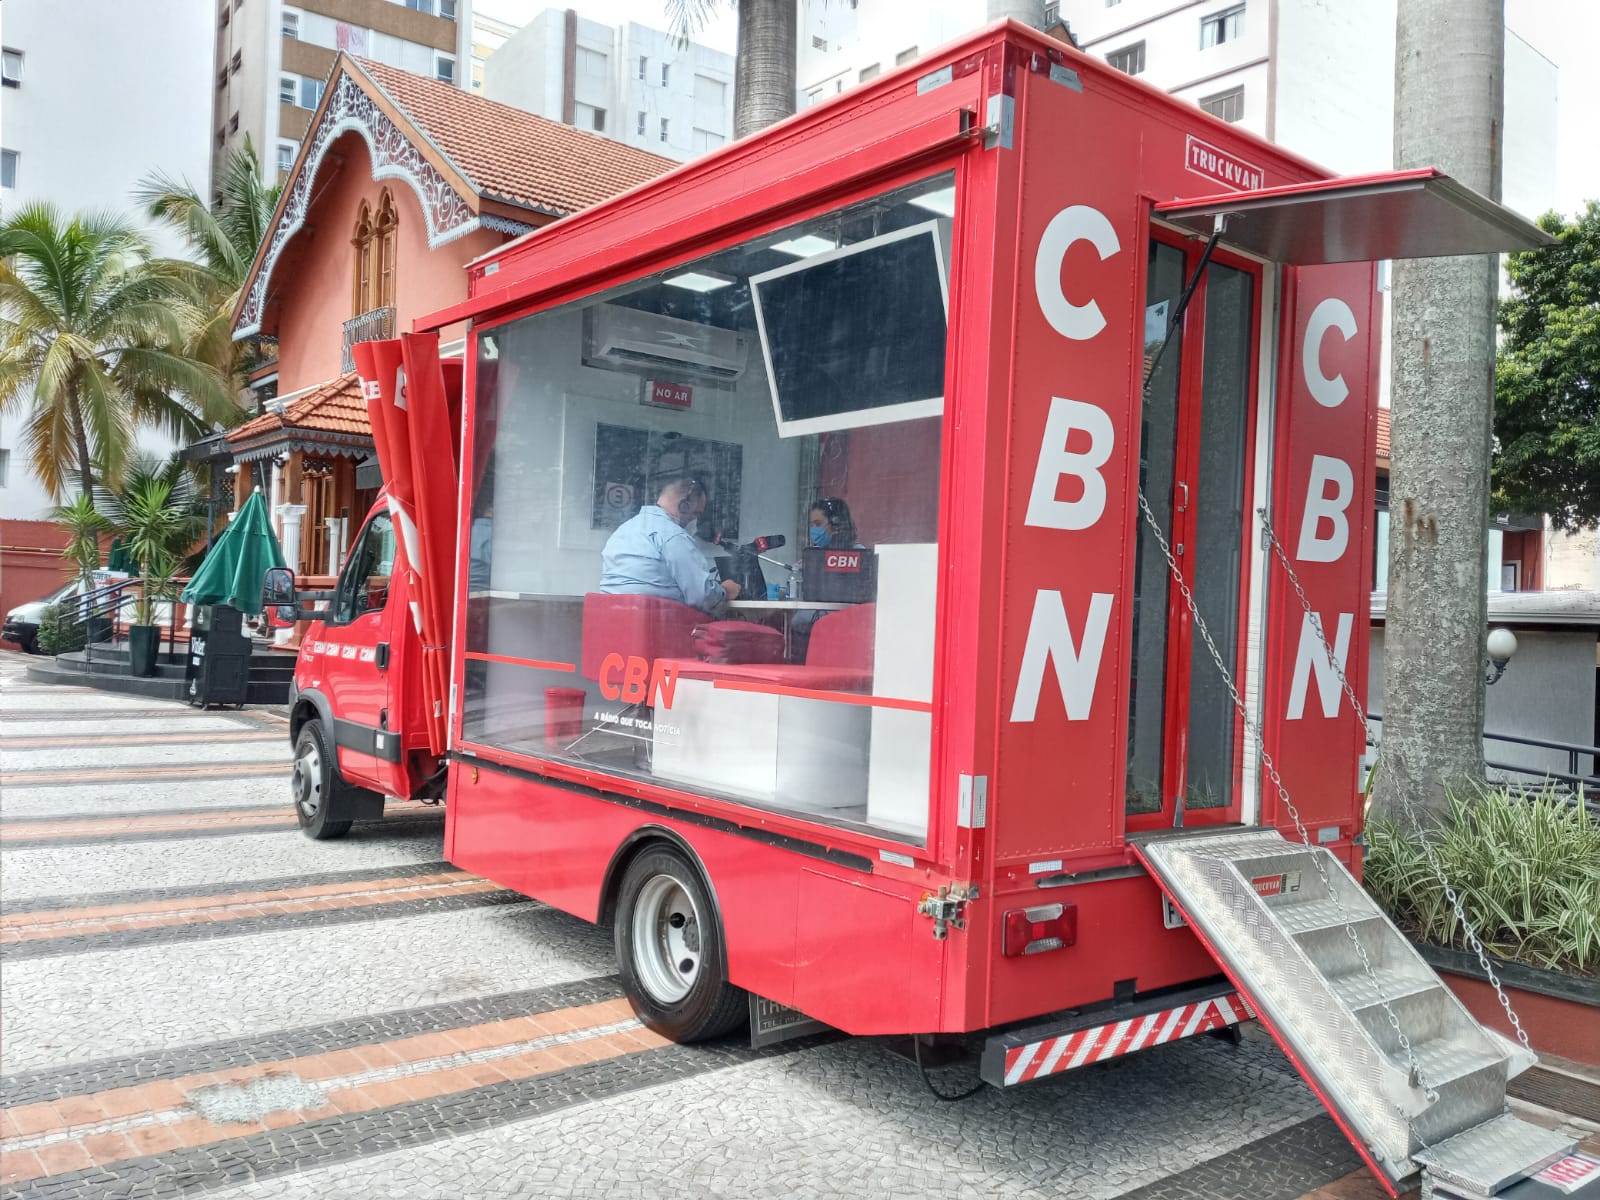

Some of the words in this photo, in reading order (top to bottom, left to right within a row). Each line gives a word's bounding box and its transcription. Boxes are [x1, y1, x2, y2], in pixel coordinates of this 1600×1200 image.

[1192, 145, 1259, 191] TRUCKVAN
[656, 387, 671, 398] NO
[674, 391, 688, 401] AR
[1010, 205, 1120, 723] CBN
[1287, 298, 1358, 720] CBN
[826, 555, 859, 568] CBN
[599, 652, 679, 710] CBN
[594, 711, 600, 720] A
[601, 712, 619, 725] RÁDIO
[620, 716, 634, 727] QUE
[635, 719, 653, 730] TOCA
[653, 723, 681, 736] NOTÍCIA
